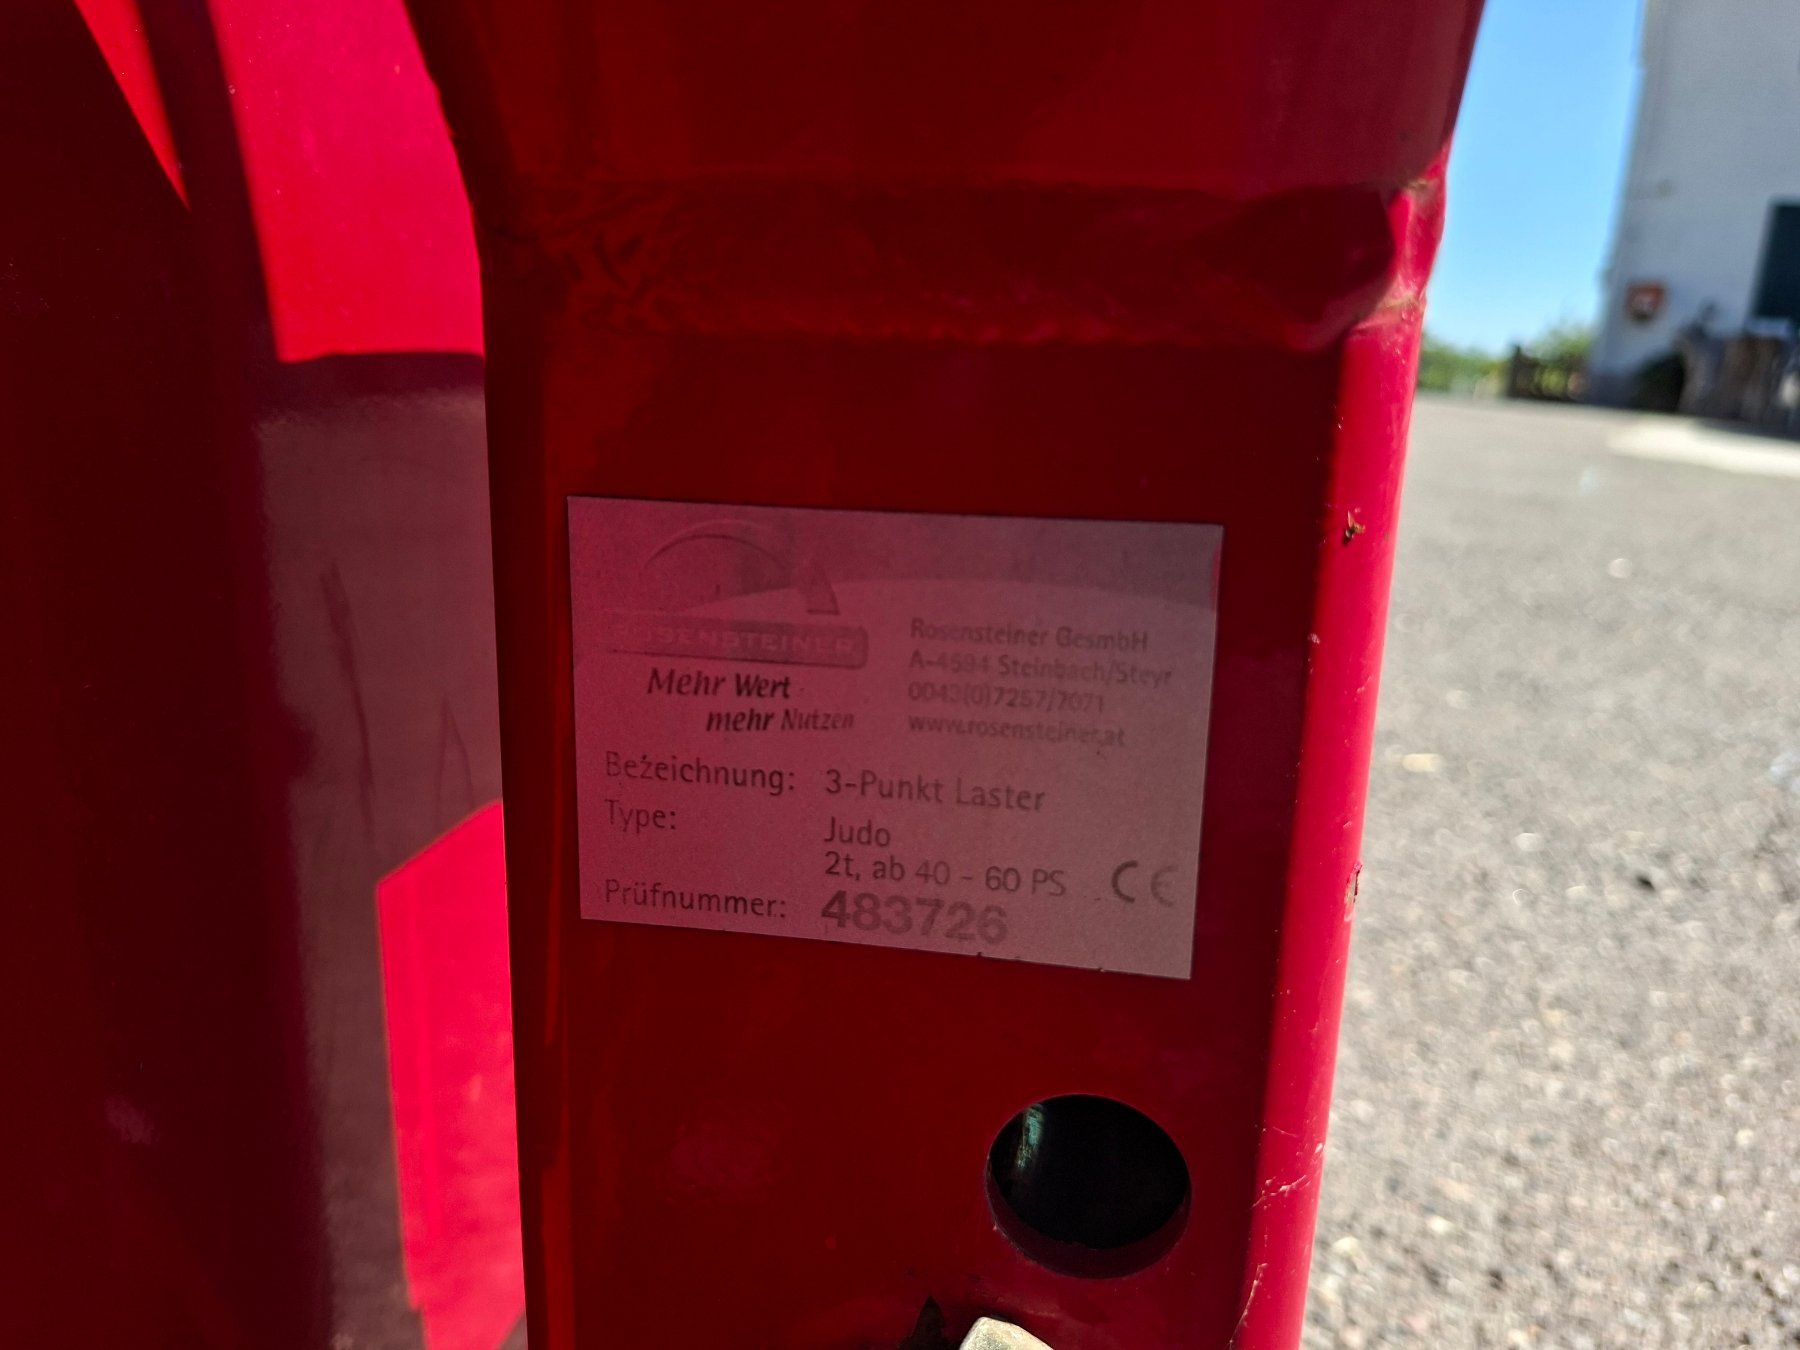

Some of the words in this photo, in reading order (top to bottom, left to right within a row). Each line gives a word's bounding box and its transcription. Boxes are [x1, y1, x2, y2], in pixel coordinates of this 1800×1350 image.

[909, 617, 1050, 647] Rosensteiner
[1055, 624, 1149, 652] GesmbH
[647, 667, 727, 697] Mehr
[734, 672, 792, 699] Wert
[998, 653, 1175, 690] Steinbach/Steyr
[705, 708, 776, 733] mehr
[780, 708, 856, 732] Nutzen
[907, 714, 1126, 746] www.rosensteiner.at
[605, 751, 796, 797] Bezeichnung:
[825, 768, 944, 803] 3-Punkt
[955, 777, 1047, 812] Laster
[604, 799, 678, 835] Type:
[823, 816, 892, 848] Judo
[823, 851, 862, 882] 2t,
[872, 857, 906, 882] ab
[914, 859, 952, 887] 40
[985, 865, 1022, 893] 60
[1031, 868, 1068, 898] PS
[604, 877, 788, 919] Prüfnummer:
[820, 889, 1010, 945] 483726
